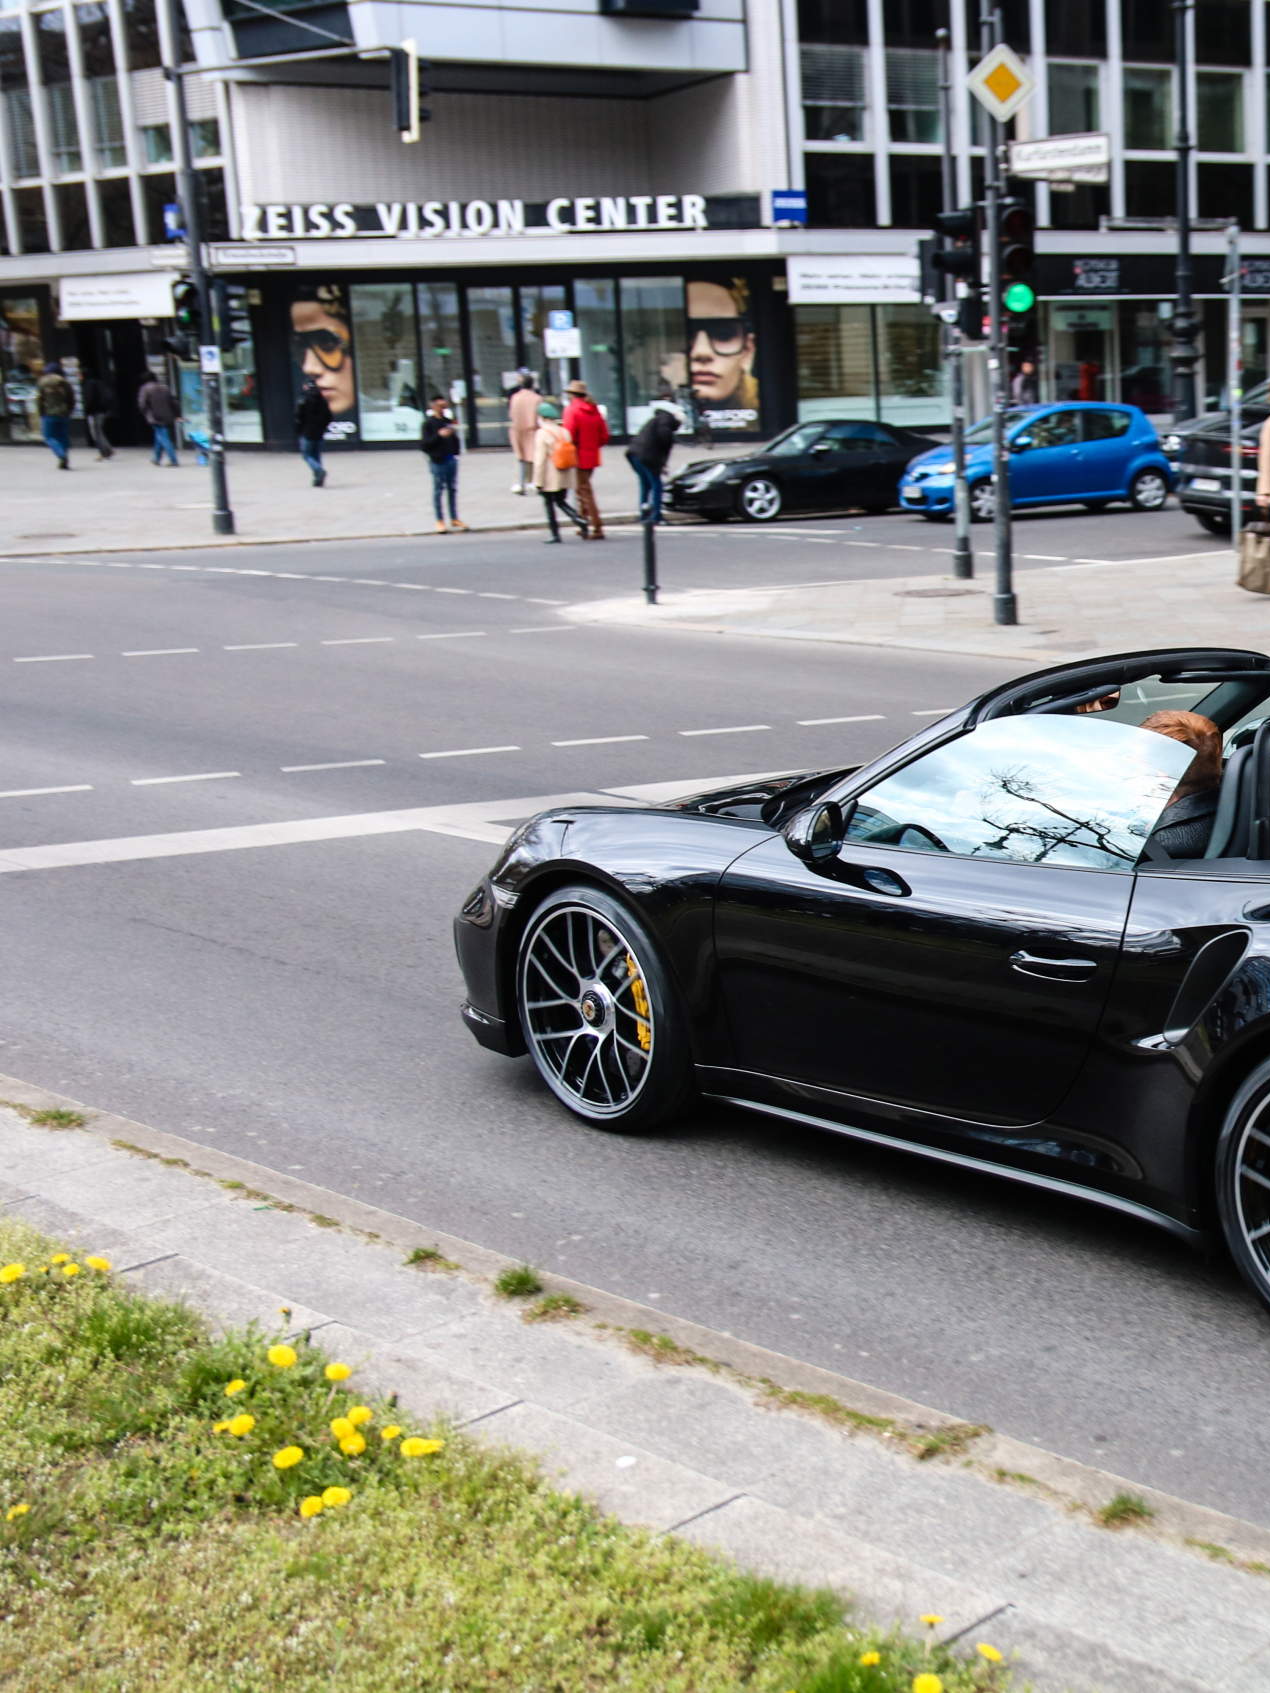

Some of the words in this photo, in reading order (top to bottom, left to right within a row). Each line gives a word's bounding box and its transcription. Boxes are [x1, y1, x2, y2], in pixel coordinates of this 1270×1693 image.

[240, 203, 357, 239] ZEISS
[375, 199, 526, 238] VISION
[546, 195, 709, 233] CENTER
